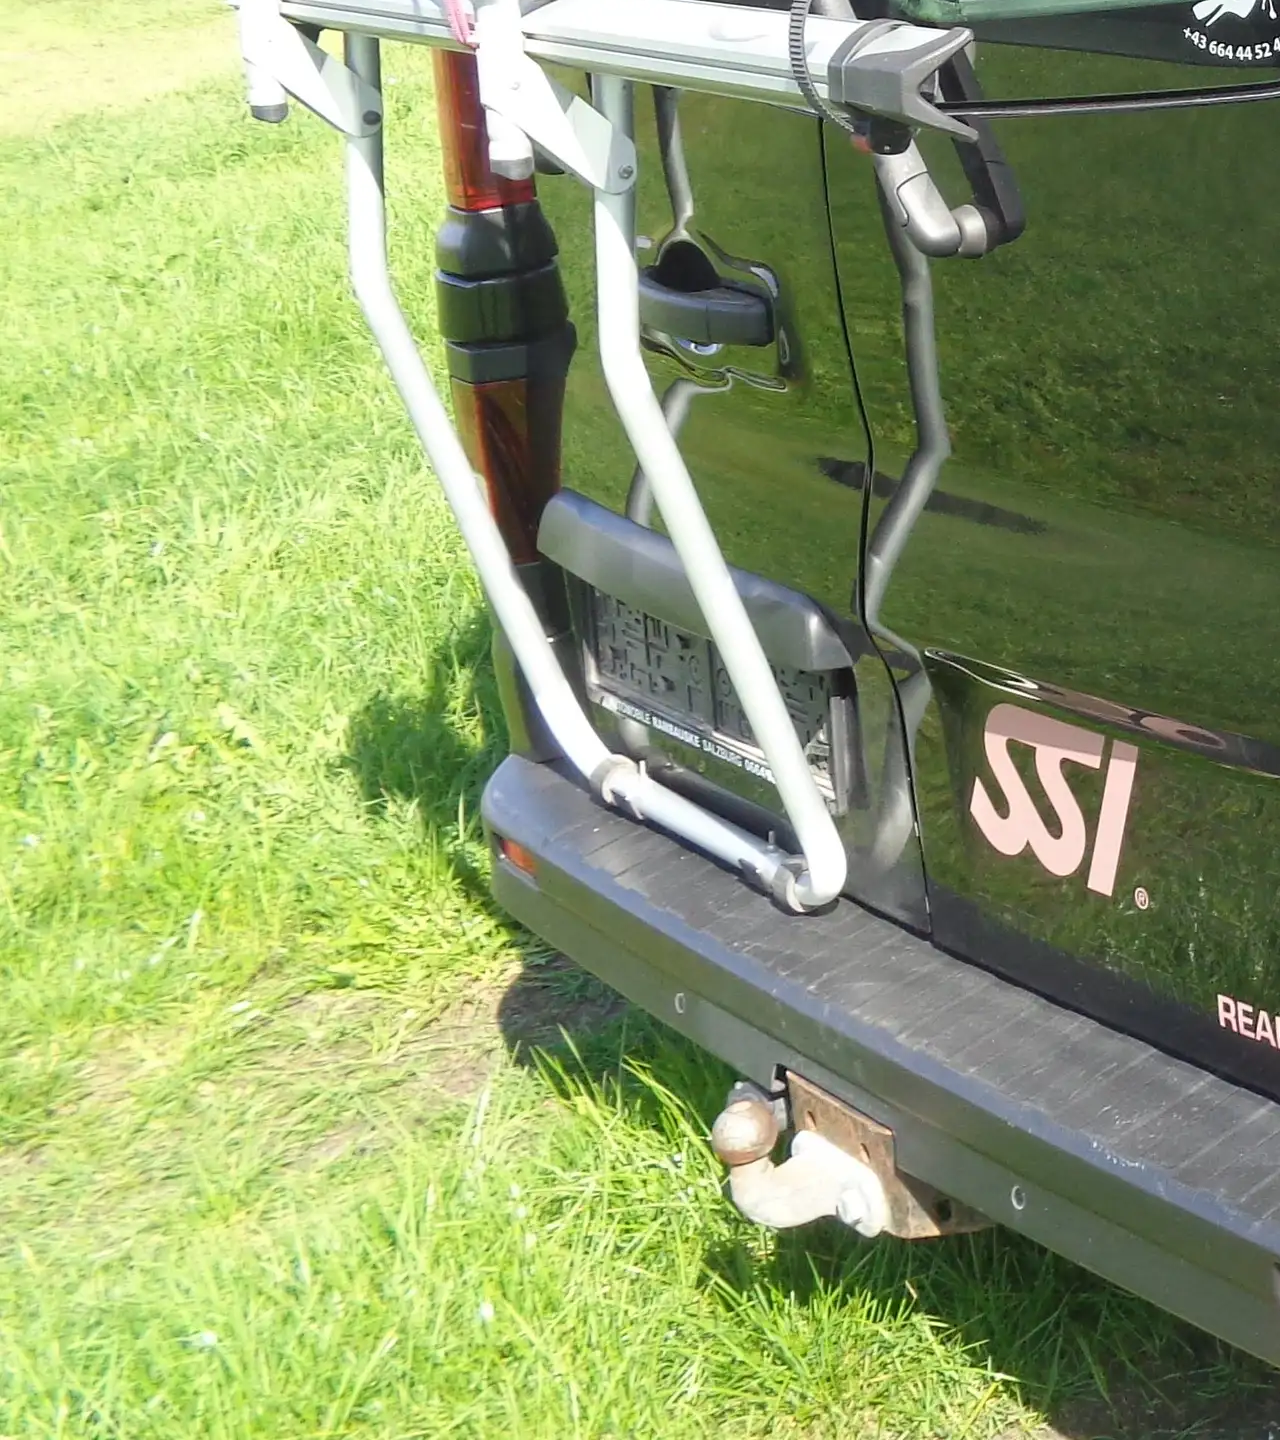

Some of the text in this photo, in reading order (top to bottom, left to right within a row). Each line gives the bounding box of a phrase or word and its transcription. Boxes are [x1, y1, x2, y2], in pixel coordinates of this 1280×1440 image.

[1183, 27, 1207, 49] +43
[1208, 41, 1233, 60] 664
[1235, 46, 1253, 61] 44
[1255, 43, 1273, 59] 52
[970, 703, 1138, 897] SSI
